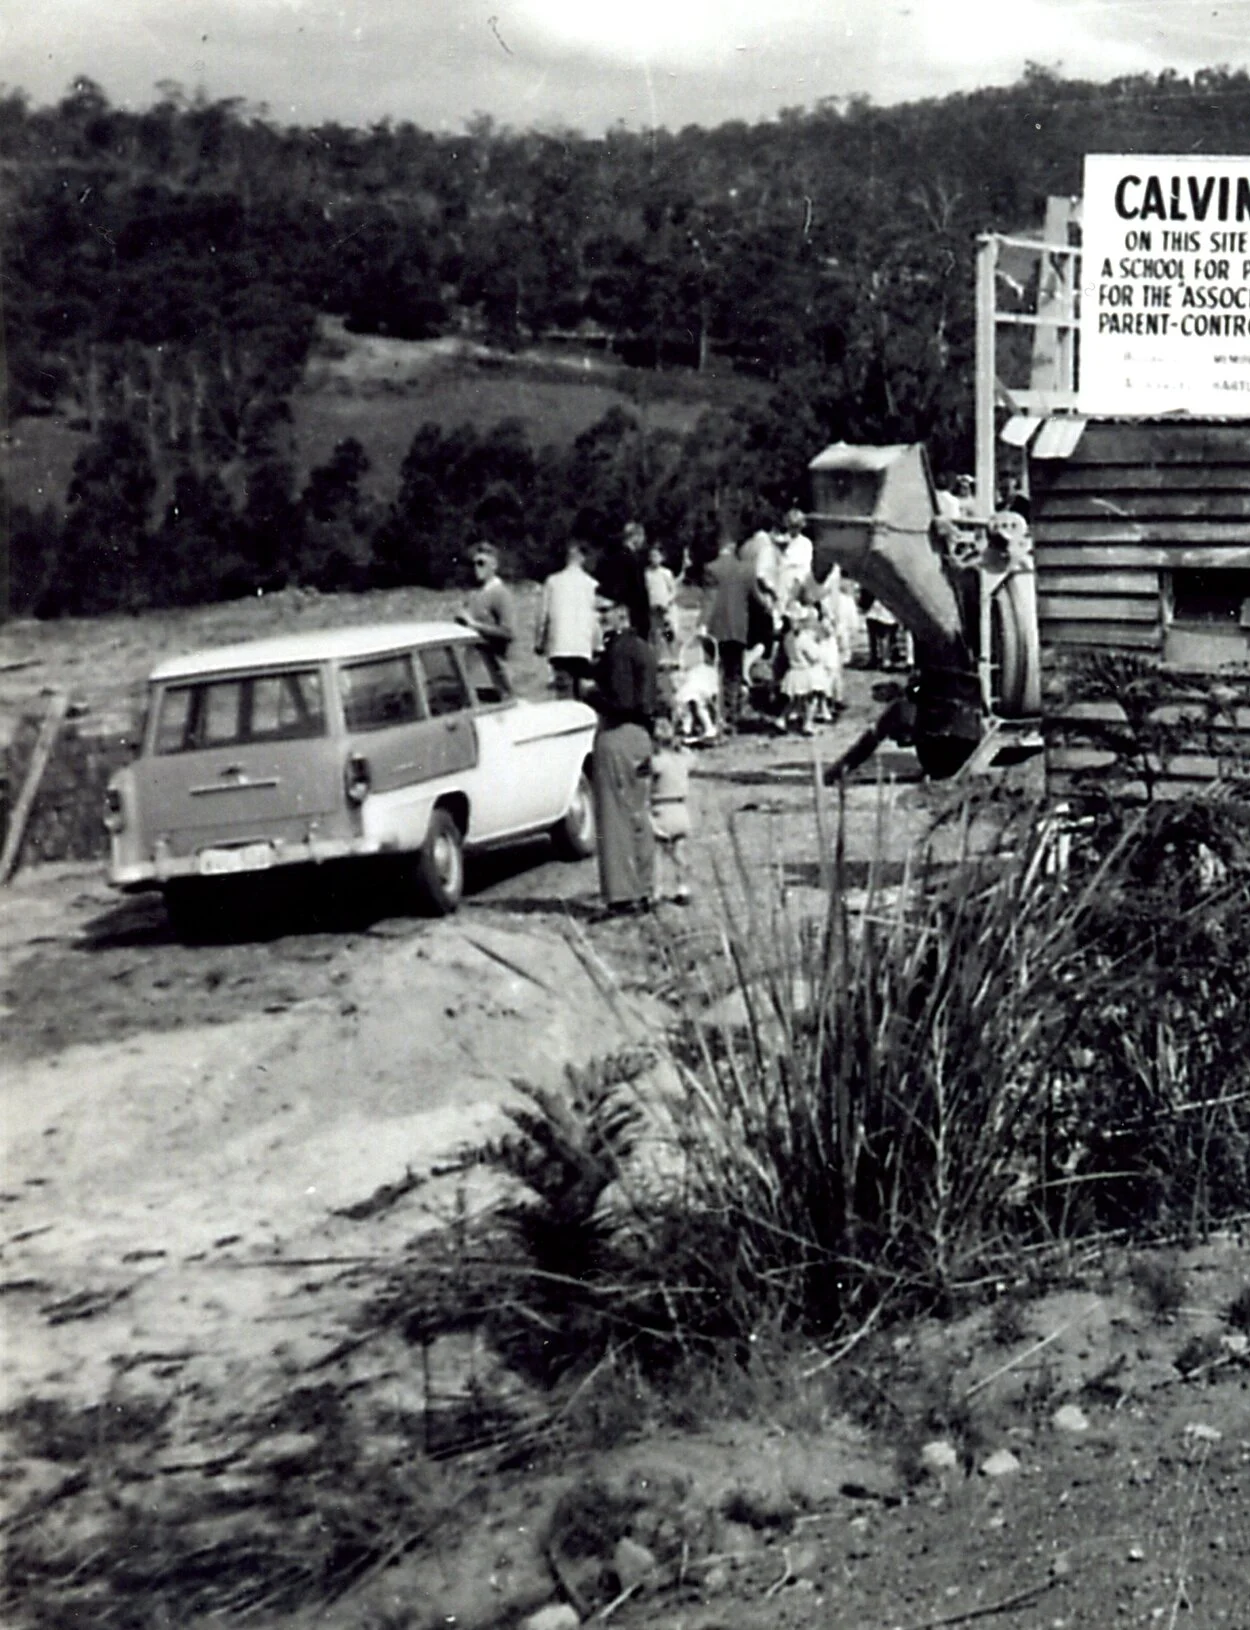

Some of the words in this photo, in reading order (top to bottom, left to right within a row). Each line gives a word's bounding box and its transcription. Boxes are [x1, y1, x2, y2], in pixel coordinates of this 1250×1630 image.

[1125, 231, 1151, 251] ON
[1163, 231, 1200, 252] THIS
[1210, 232, 1246, 253] SITE
[1102, 258, 1113, 277] A
[1120, 258, 1184, 280] SCHOOL
[1195, 259, 1229, 280] FOR
[1100, 285, 1133, 306] FOR
[1143, 285, 1171, 307] THE
